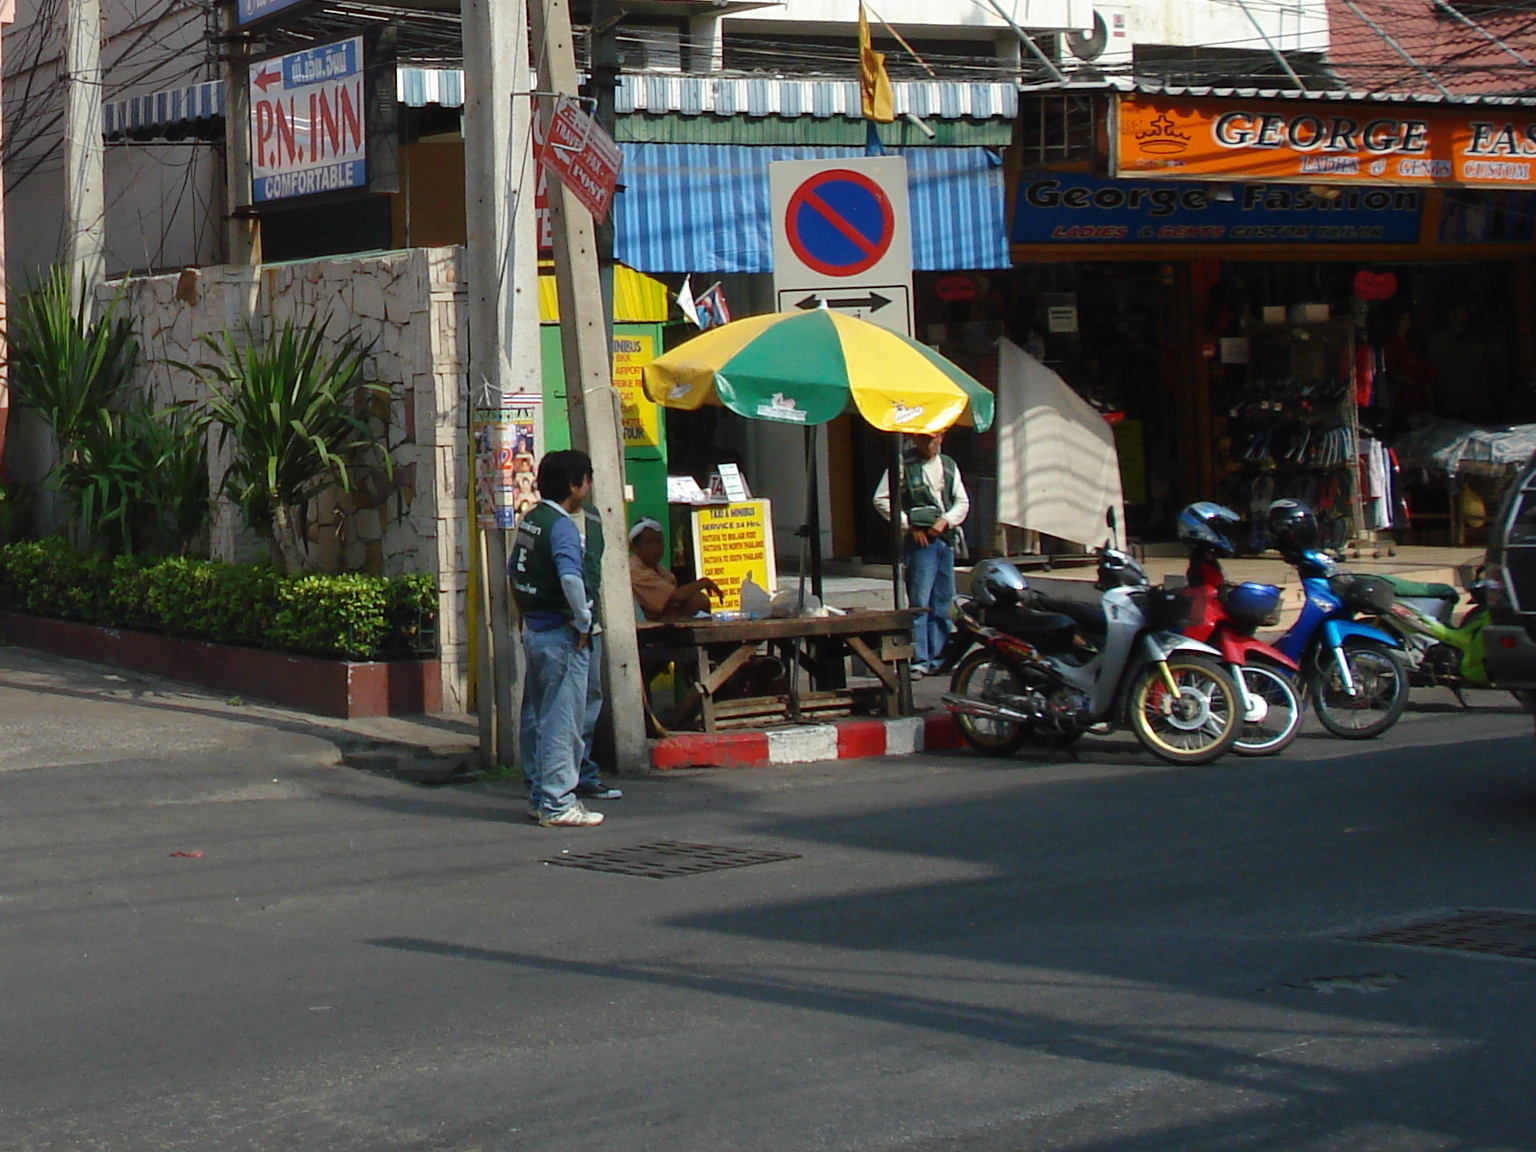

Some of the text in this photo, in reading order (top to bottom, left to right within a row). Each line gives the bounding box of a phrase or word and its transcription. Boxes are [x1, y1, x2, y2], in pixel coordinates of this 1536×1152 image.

[310, 81, 362, 163] INN
[1212, 110, 1428, 155] GEORGE
[265, 163, 354, 199] COMFORTABLE
[573, 165, 606, 202] POST
[1301, 156, 1360, 175] LADIES
[1398, 159, 1452, 178] GENTS
[1465, 160, 1531, 180] CUSTOM
[1025, 179, 1420, 217] George Fashion
[1051, 225, 1385, 239] LADIES & GENTS CUSTOM TAILOR
[702, 521, 734, 531] SERVICE
